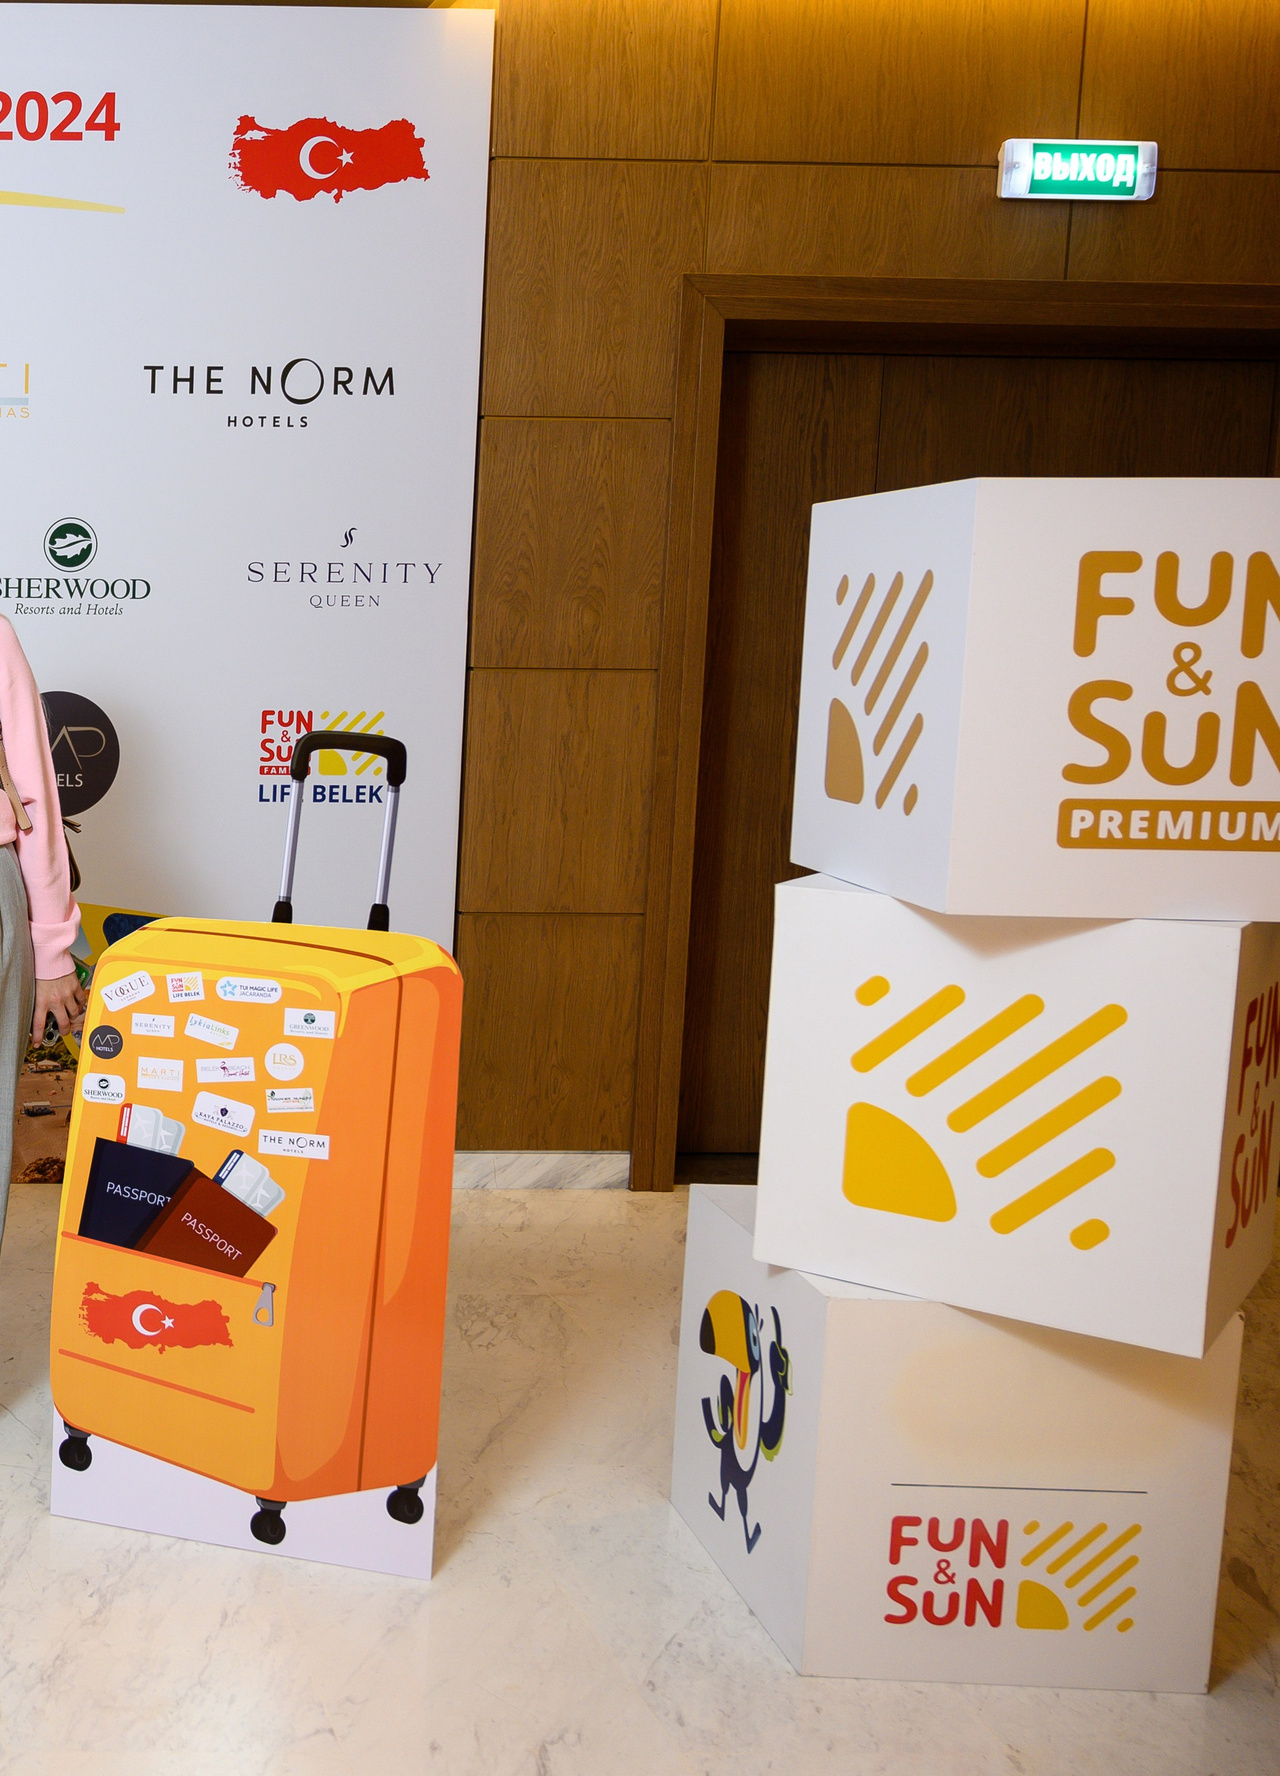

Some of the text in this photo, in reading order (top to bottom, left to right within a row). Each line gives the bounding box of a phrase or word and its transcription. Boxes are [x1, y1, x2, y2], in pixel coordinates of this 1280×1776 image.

[1033, 151, 1136, 188] ВЫХОД
[143, 357, 396, 406] THE NORM
[226, 415, 309, 428] HOTELS
[247, 561, 444, 585] SERENITY
[14, 601, 125, 616] Resorts and Hotels
[308, 594, 381, 609] QUEEN
[1166, 640, 1213, 697] &
[260, 709, 313, 735] FUN
[280, 729, 291, 743] &
[260, 738, 311, 763] SU
[56, 773, 84, 788] ELS
[263, 766, 291, 775] FAM
[259, 784, 384, 804] LIF BELEK
[104, 974, 150, 1002] VOGUE
[134, 1021, 171, 1030] SERENITY
[272, 1052, 297, 1067] LRS
[140, 1066, 181, 1077] MARTI
[83, 1088, 123, 1099] SHERWOOD
[262, 1134, 326, 1149] THE NORM
[180, 1211, 243, 1262] PASSPORT
[888, 1514, 1010, 1569] FUN
[933, 1557, 956, 1585] &
[883, 1574, 1005, 1629] SUN
